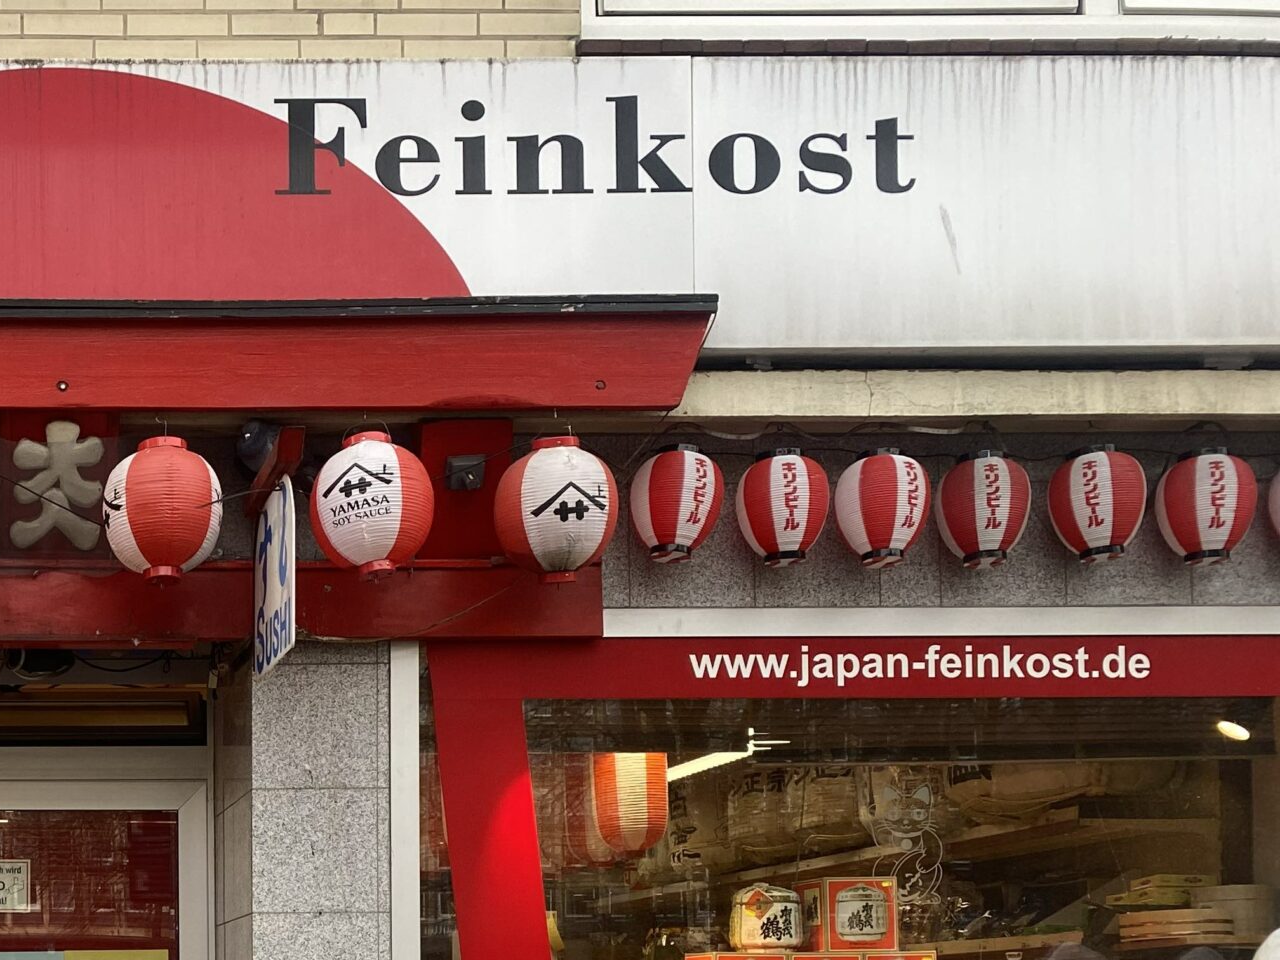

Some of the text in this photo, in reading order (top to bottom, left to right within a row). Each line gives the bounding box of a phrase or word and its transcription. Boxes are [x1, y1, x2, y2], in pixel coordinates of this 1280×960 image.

[274, 96, 917, 196] Feinkost
[330, 494, 390, 518] YAMASA
[332, 505, 392, 528] SOY SAUCE
[686, 457, 709, 525] キリンビール
[781, 462, 800, 531] キリンビール
[901, 461, 919, 529] キリンビール
[984, 463, 1002, 529] キリンビール
[1082, 460, 1105, 528] キリンビール
[1208, 460, 1226, 529] キリンビール
[255, 597, 292, 675] SUSHI
[689, 645, 1152, 687] www.japan-feinkost.de
[5, 865, 22, 874] wird
